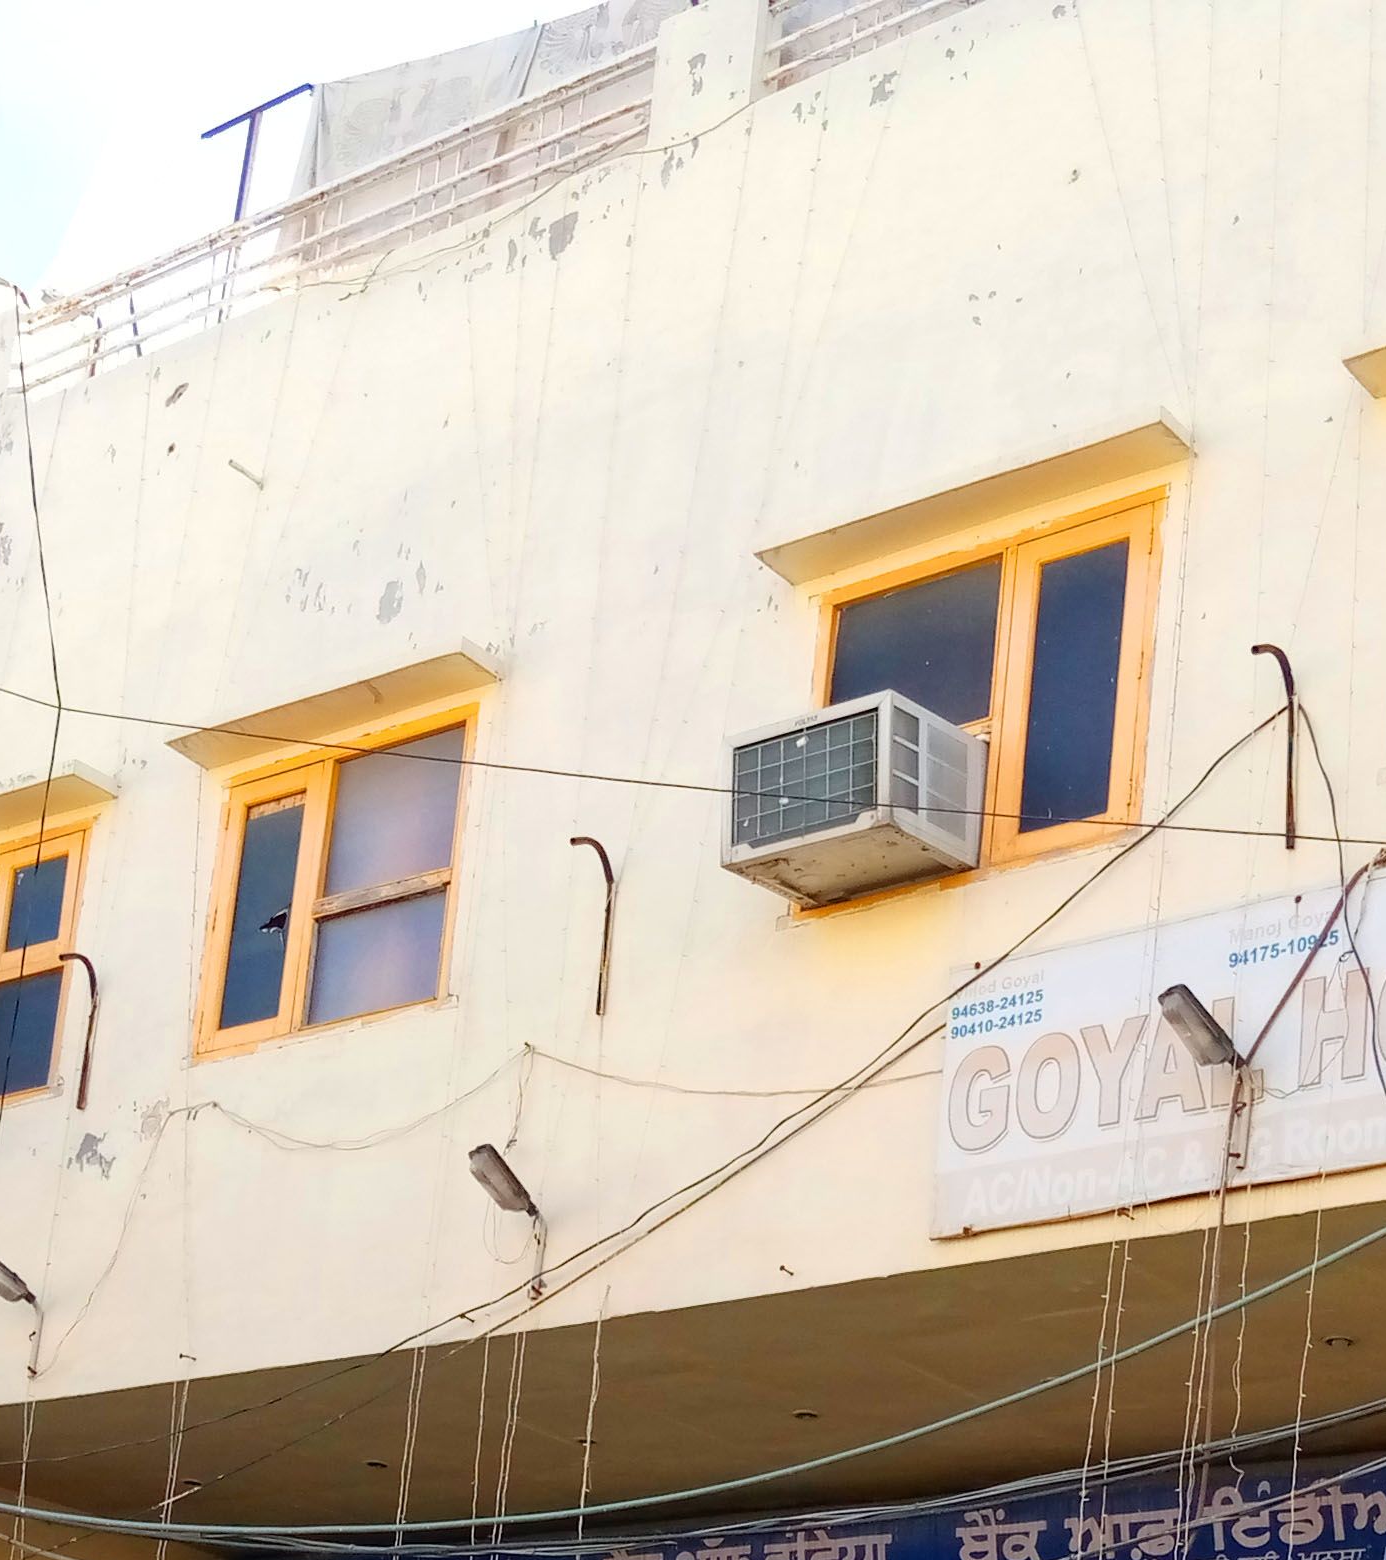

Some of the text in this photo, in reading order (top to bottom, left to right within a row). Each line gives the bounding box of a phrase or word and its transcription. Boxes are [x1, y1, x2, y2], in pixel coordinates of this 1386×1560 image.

[951, 988, 1044, 1021] 94638-24125
[950, 1008, 1043, 1040] 90410-24125
[946, 996, 1265, 1156] GOYAL
